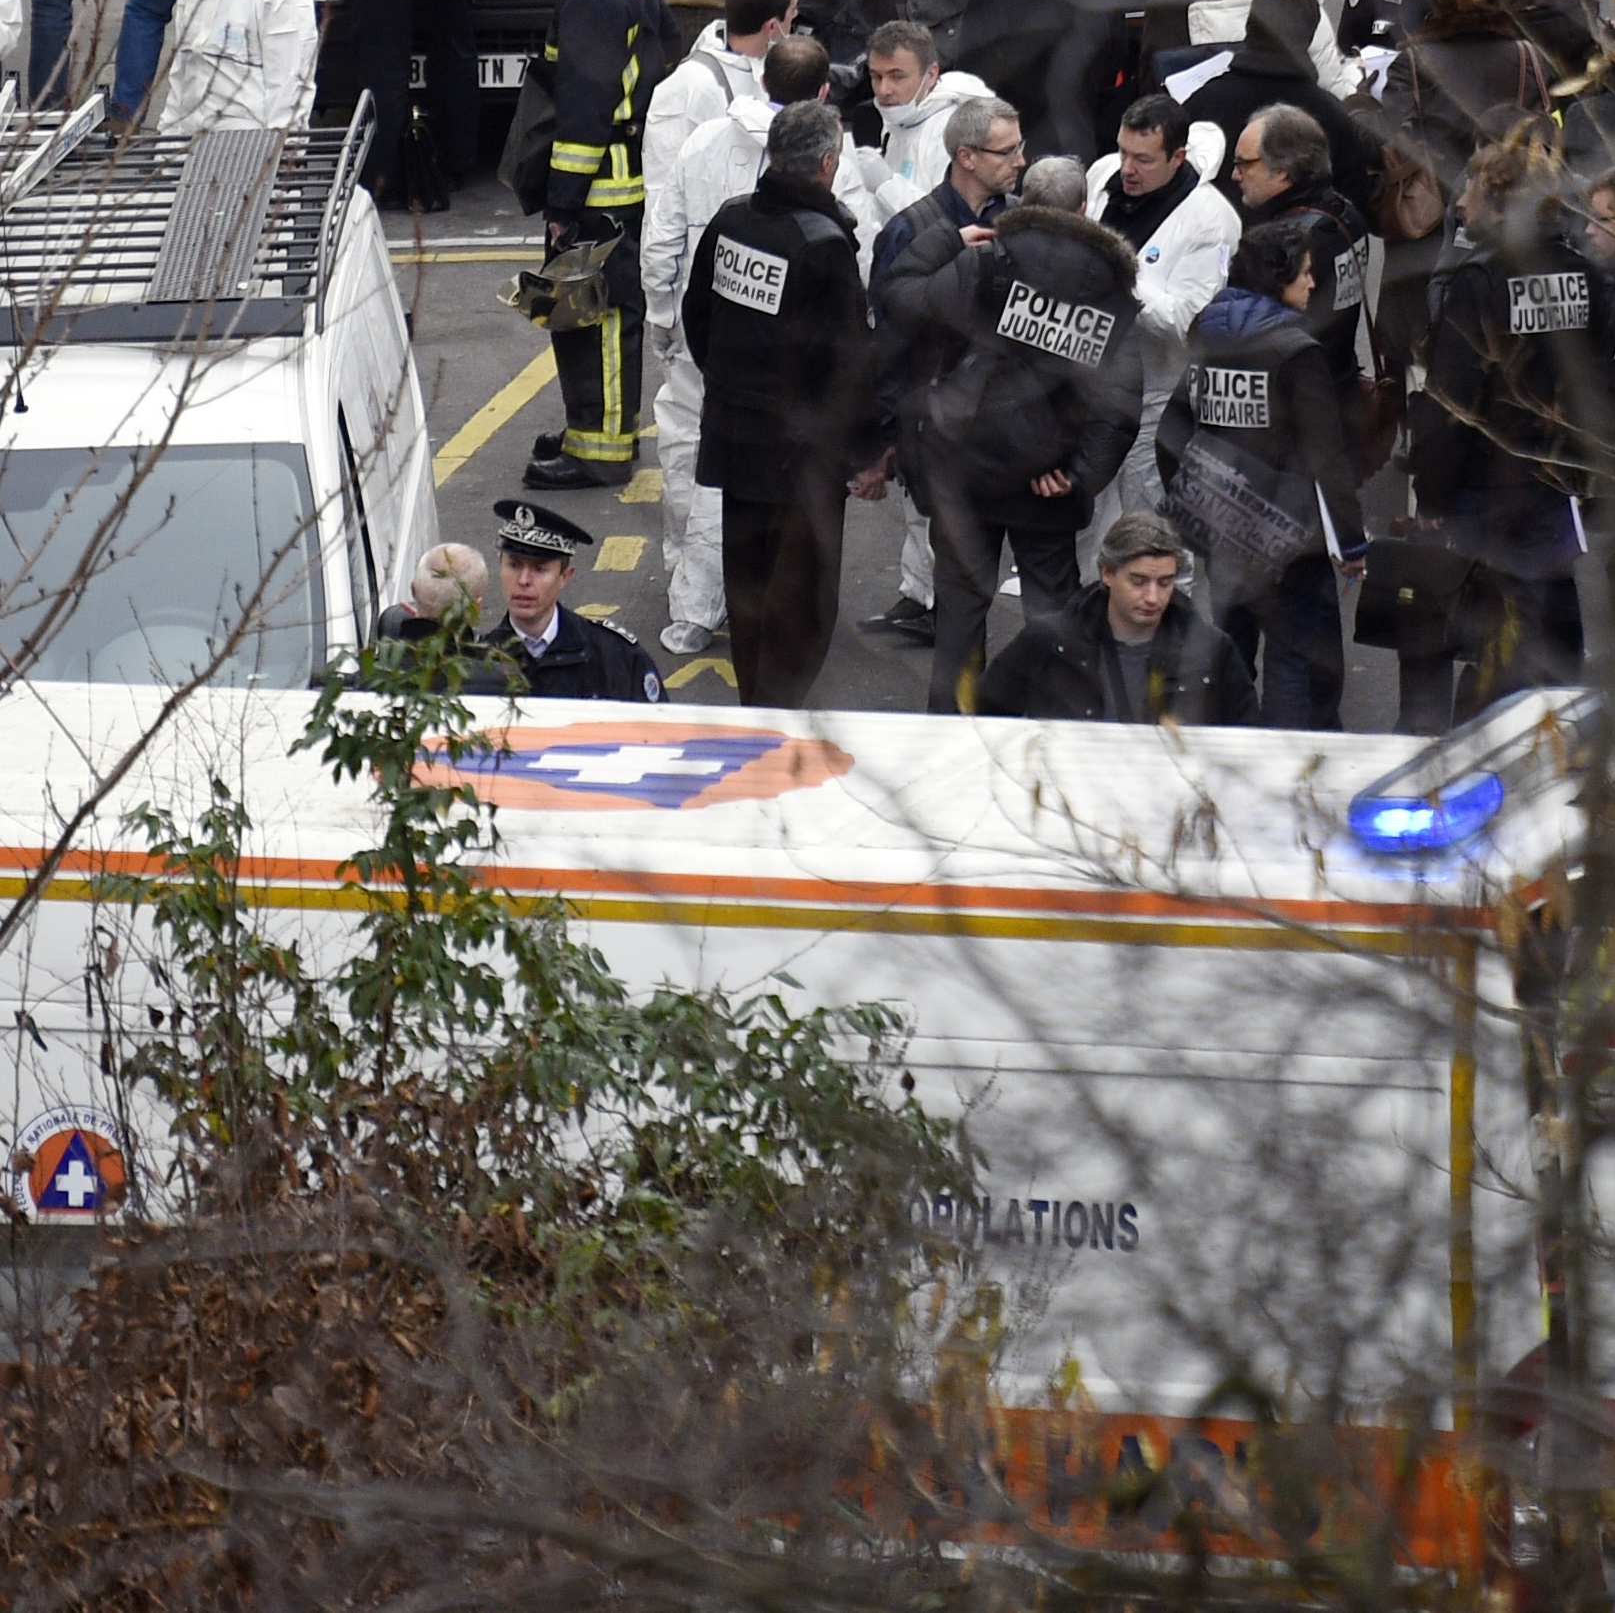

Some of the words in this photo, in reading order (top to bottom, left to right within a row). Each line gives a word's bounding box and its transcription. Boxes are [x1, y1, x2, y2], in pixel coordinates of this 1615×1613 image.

[715, 244, 782, 287] POLICE
[714, 272, 777, 306] UDICIAIRE
[1513, 275, 1588, 307] POLICE
[1008, 283, 1112, 344] POLICE
[1513, 304, 1588, 332] JUDICIAIRE
[1001, 313, 1104, 368] JUDICIAIRE
[1202, 397, 1266, 426] DICIAIRE
[27, 1113, 79, 1145] NATIONALE
[83, 1113, 98, 1126] DE
[908, 1195, 1140, 1254] OPULATIONS
